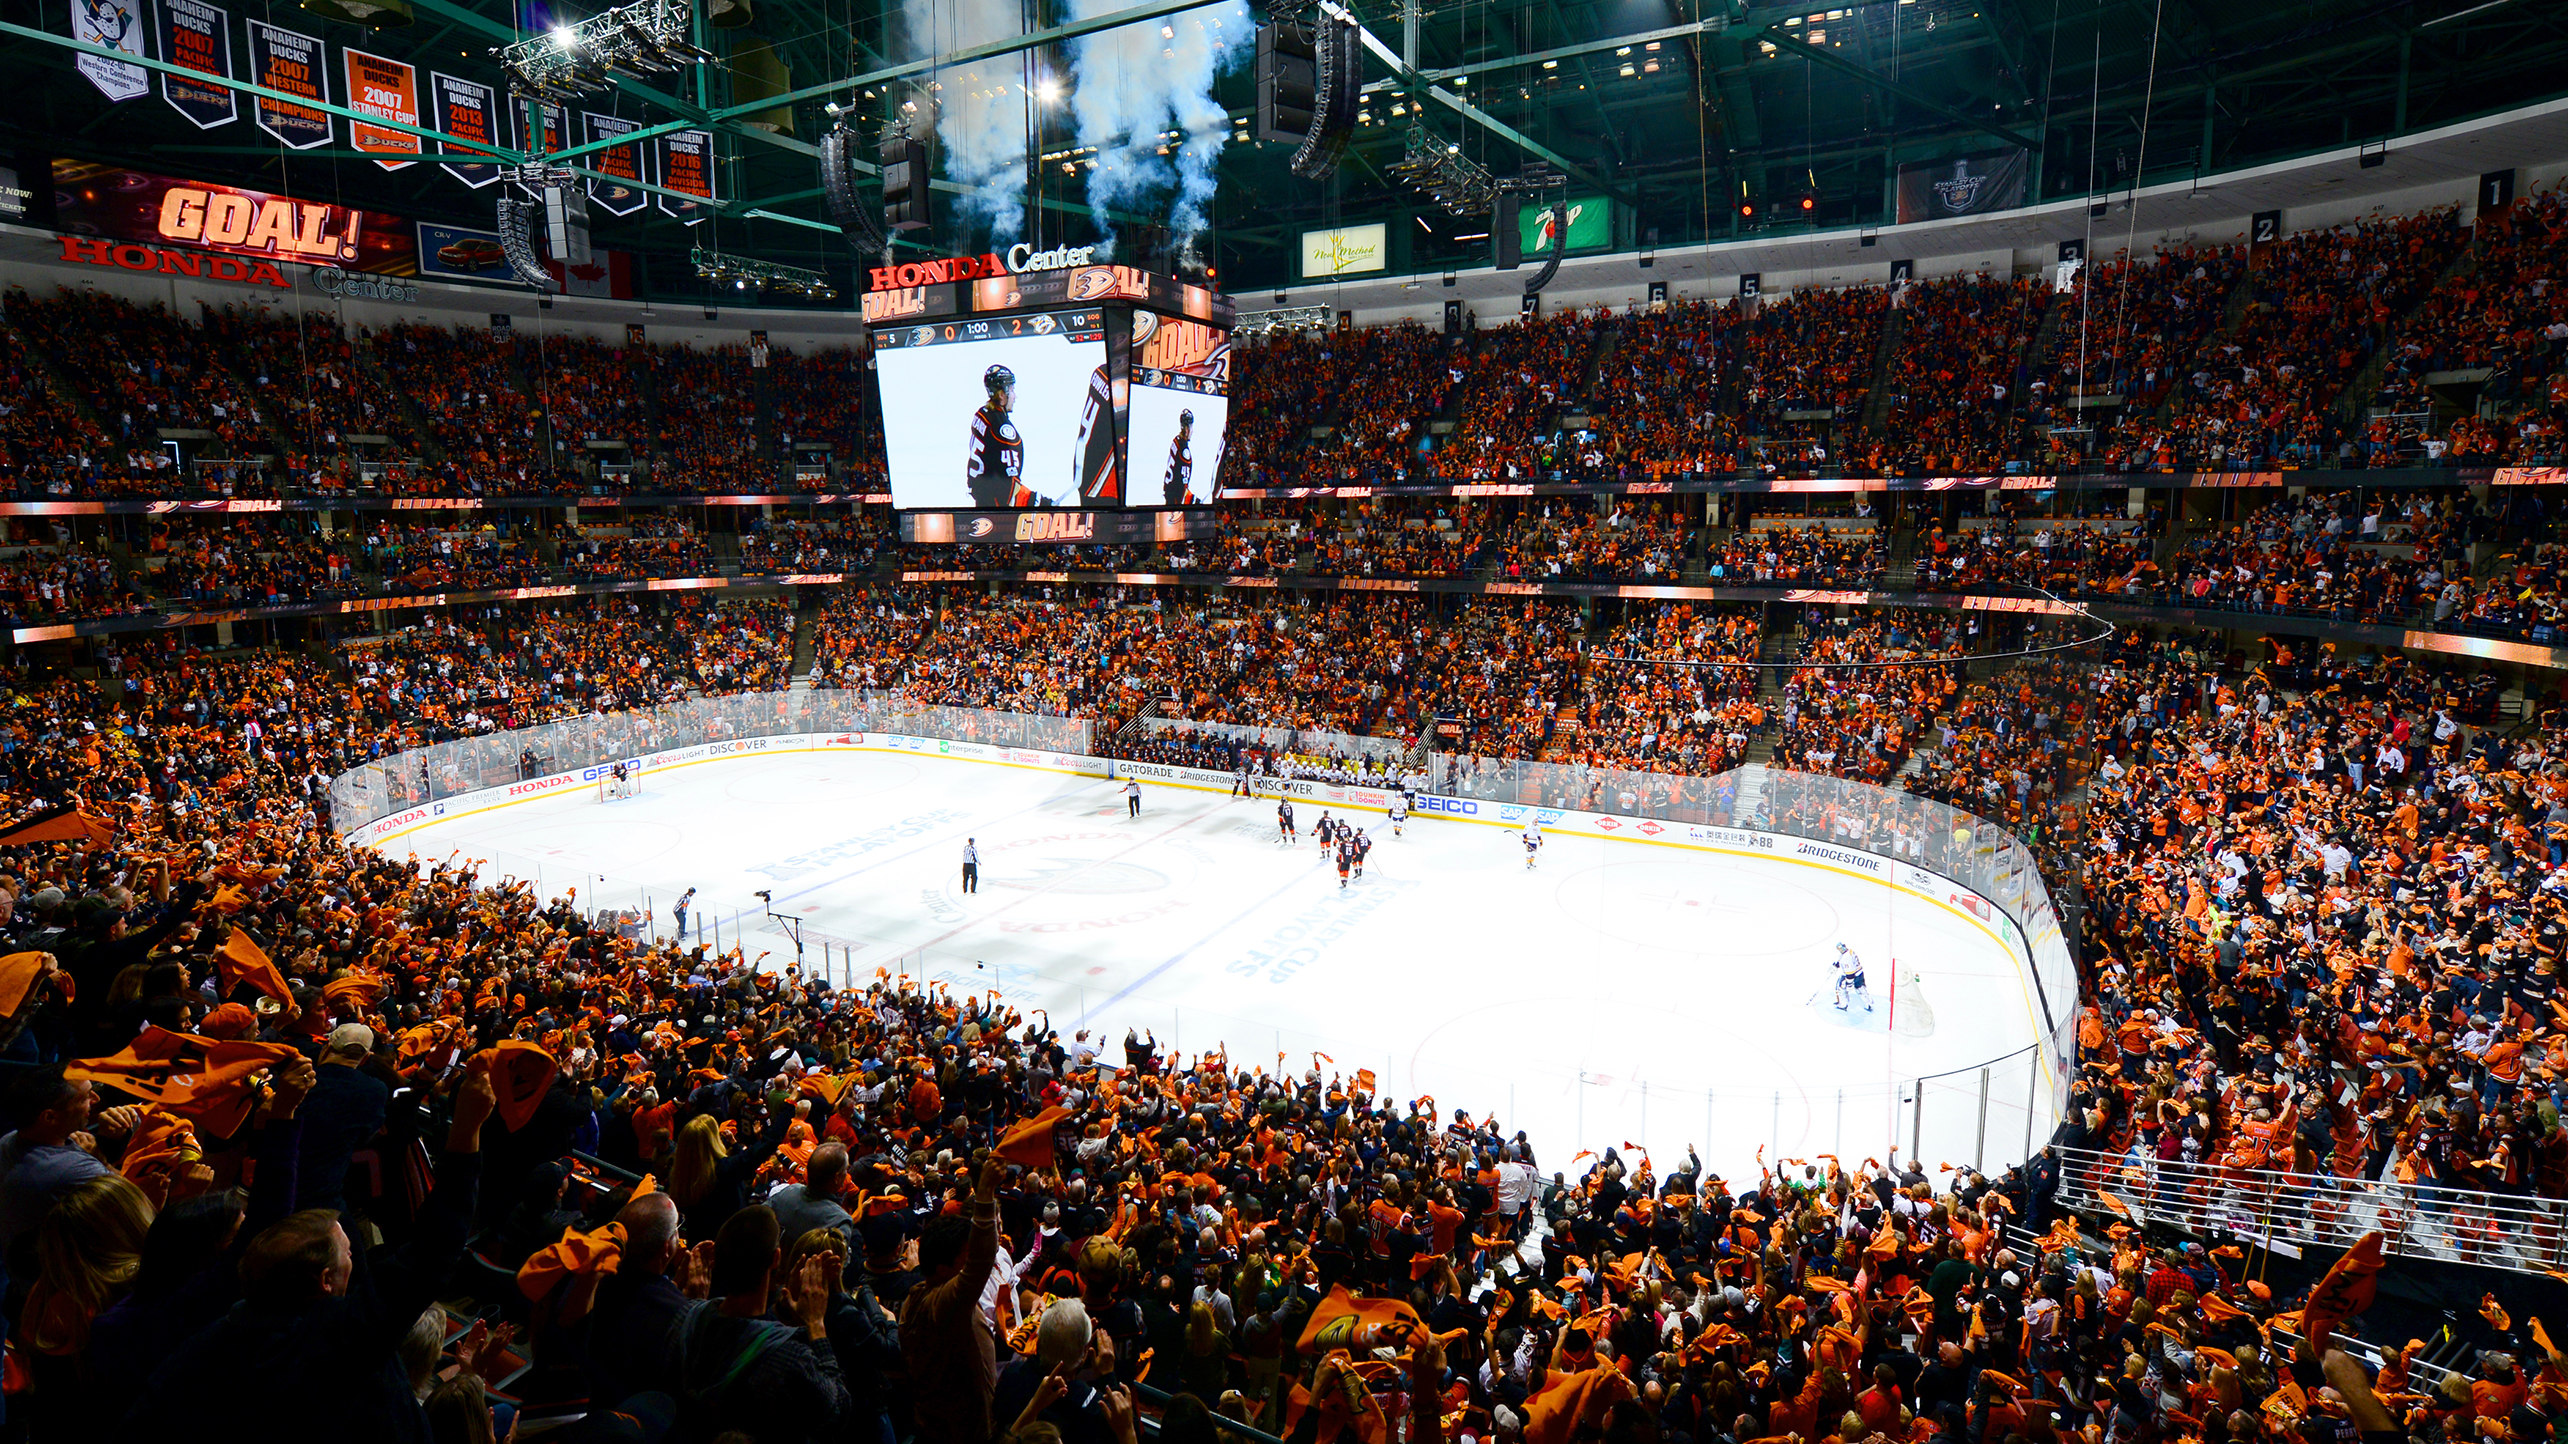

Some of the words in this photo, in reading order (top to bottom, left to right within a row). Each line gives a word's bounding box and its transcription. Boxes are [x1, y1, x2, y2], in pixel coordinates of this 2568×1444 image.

[166, 0, 215, 23] ANAHEIM
[173, 11, 211, 35] DUCKS
[172, 26, 214, 55] 2007
[262, 27, 312, 53] ANAHEIM
[175, 47, 215, 69] PACIFIC
[269, 42, 308, 64] DUCKS
[82, 57, 108, 74] Western
[109, 68, 144, 86] Conference
[269, 56, 310, 81] 2007
[358, 55, 404, 77] ANAHEIM
[97, 72, 130, 90] Champions
[264, 72, 317, 96] WESTERN
[364, 69, 400, 88] DUCKS
[363, 86, 403, 109] 2007
[443, 79, 485, 99] ANAHEIM
[449, 91, 481, 109] DUCKS
[260, 97, 326, 123] CHAMPIONS
[353, 101, 394, 121] STANLEY
[395, 111, 416, 125] CUP
[449, 104, 483, 126] 2013
[451, 121, 485, 137] PACIFIC
[593, 117, 632, 132] ANAHEIM
[664, 131, 703, 145] ANAHEIM
[669, 141, 700, 155] DUCKS
[600, 156, 632, 169] PACIFIC
[669, 152, 701, 170] 2016
[597, 164, 636, 178] DIVISION
[671, 167, 702, 179] PACIFIC
[668, 176, 706, 188] DIVISION
[5, 187, 33, 199] NOW!
[159, 187, 362, 262] GOAL!
[2257, 219, 2273, 241] 2
[2065, 247, 2077, 262] 3
[57, 235, 292, 289] HONDA
[312, 266, 421, 302] Center
[869, 253, 1007, 291] HONDA
[1007, 242, 1094, 273] Center
[1894, 266, 1906, 280] 4
[1068, 265, 1150, 300] GAL!
[1744, 279, 1755, 296] 5
[1652, 288, 1663, 303] 6
[1525, 299, 1537, 317] 7
[889, 334, 896, 344] 5
[944, 326, 955, 342] 0
[967, 322, 989, 334] 1:00
[1012, 319, 1022, 335] 2
[1072, 314, 1085, 327] 10
[1164, 374, 1171, 386] 0
[1196, 379, 1201, 391] 2
[1000, 449, 1020, 468] 45
[1337, 486, 1372, 498] GOAL!
[2000, 476, 2057, 490] GOAL!
[227, 500, 282, 512] GOAL!
[1016, 512, 1094, 543] GOAL!
[710, 739, 767, 755] DISCOVER
[888, 736, 901, 746] SAP
[910, 738, 922, 748] SAP
[941, 741, 984, 755] enterprise
[682, 749, 705, 759] LIGHT
[1060, 756, 1083, 768] Coors
[1083, 761, 1102, 770] LIGHT
[583, 759, 641, 781] GEO
[1119, 763, 1173, 778] GATORADE
[1180, 770, 1236, 785] BRIDGESTONE
[509, 775, 574, 796] HONDA
[1257, 778, 1313, 795] DISCVER
[445, 797, 470, 808] PACIFIC
[471, 790, 501, 801] PREMIER
[1358, 792, 1386, 800] DUNKIN'
[1358, 798, 1385, 806] DONUTS
[1417, 796, 1478, 815] GEICO
[1501, 806, 1523, 818] SAP
[373, 809, 427, 835] HONDA
[1537, 810, 1560, 822] SAP
[1597, 819, 1619, 828] ORKIN
[1639, 824, 1661, 832] ORKIN
[783, 824, 899, 865] STANLEY
[812, 810, 974, 870] PLAYOFFS
[1360, 838, 1368, 847] 33
[1759, 836, 1773, 848] 88
[1345, 847, 1352, 856] 15
[1798, 843, 1880, 872] BRIDGESTONE
[1003, 985, 1042, 1002] LIFE
[2252, 1135, 2271, 1155] 17
